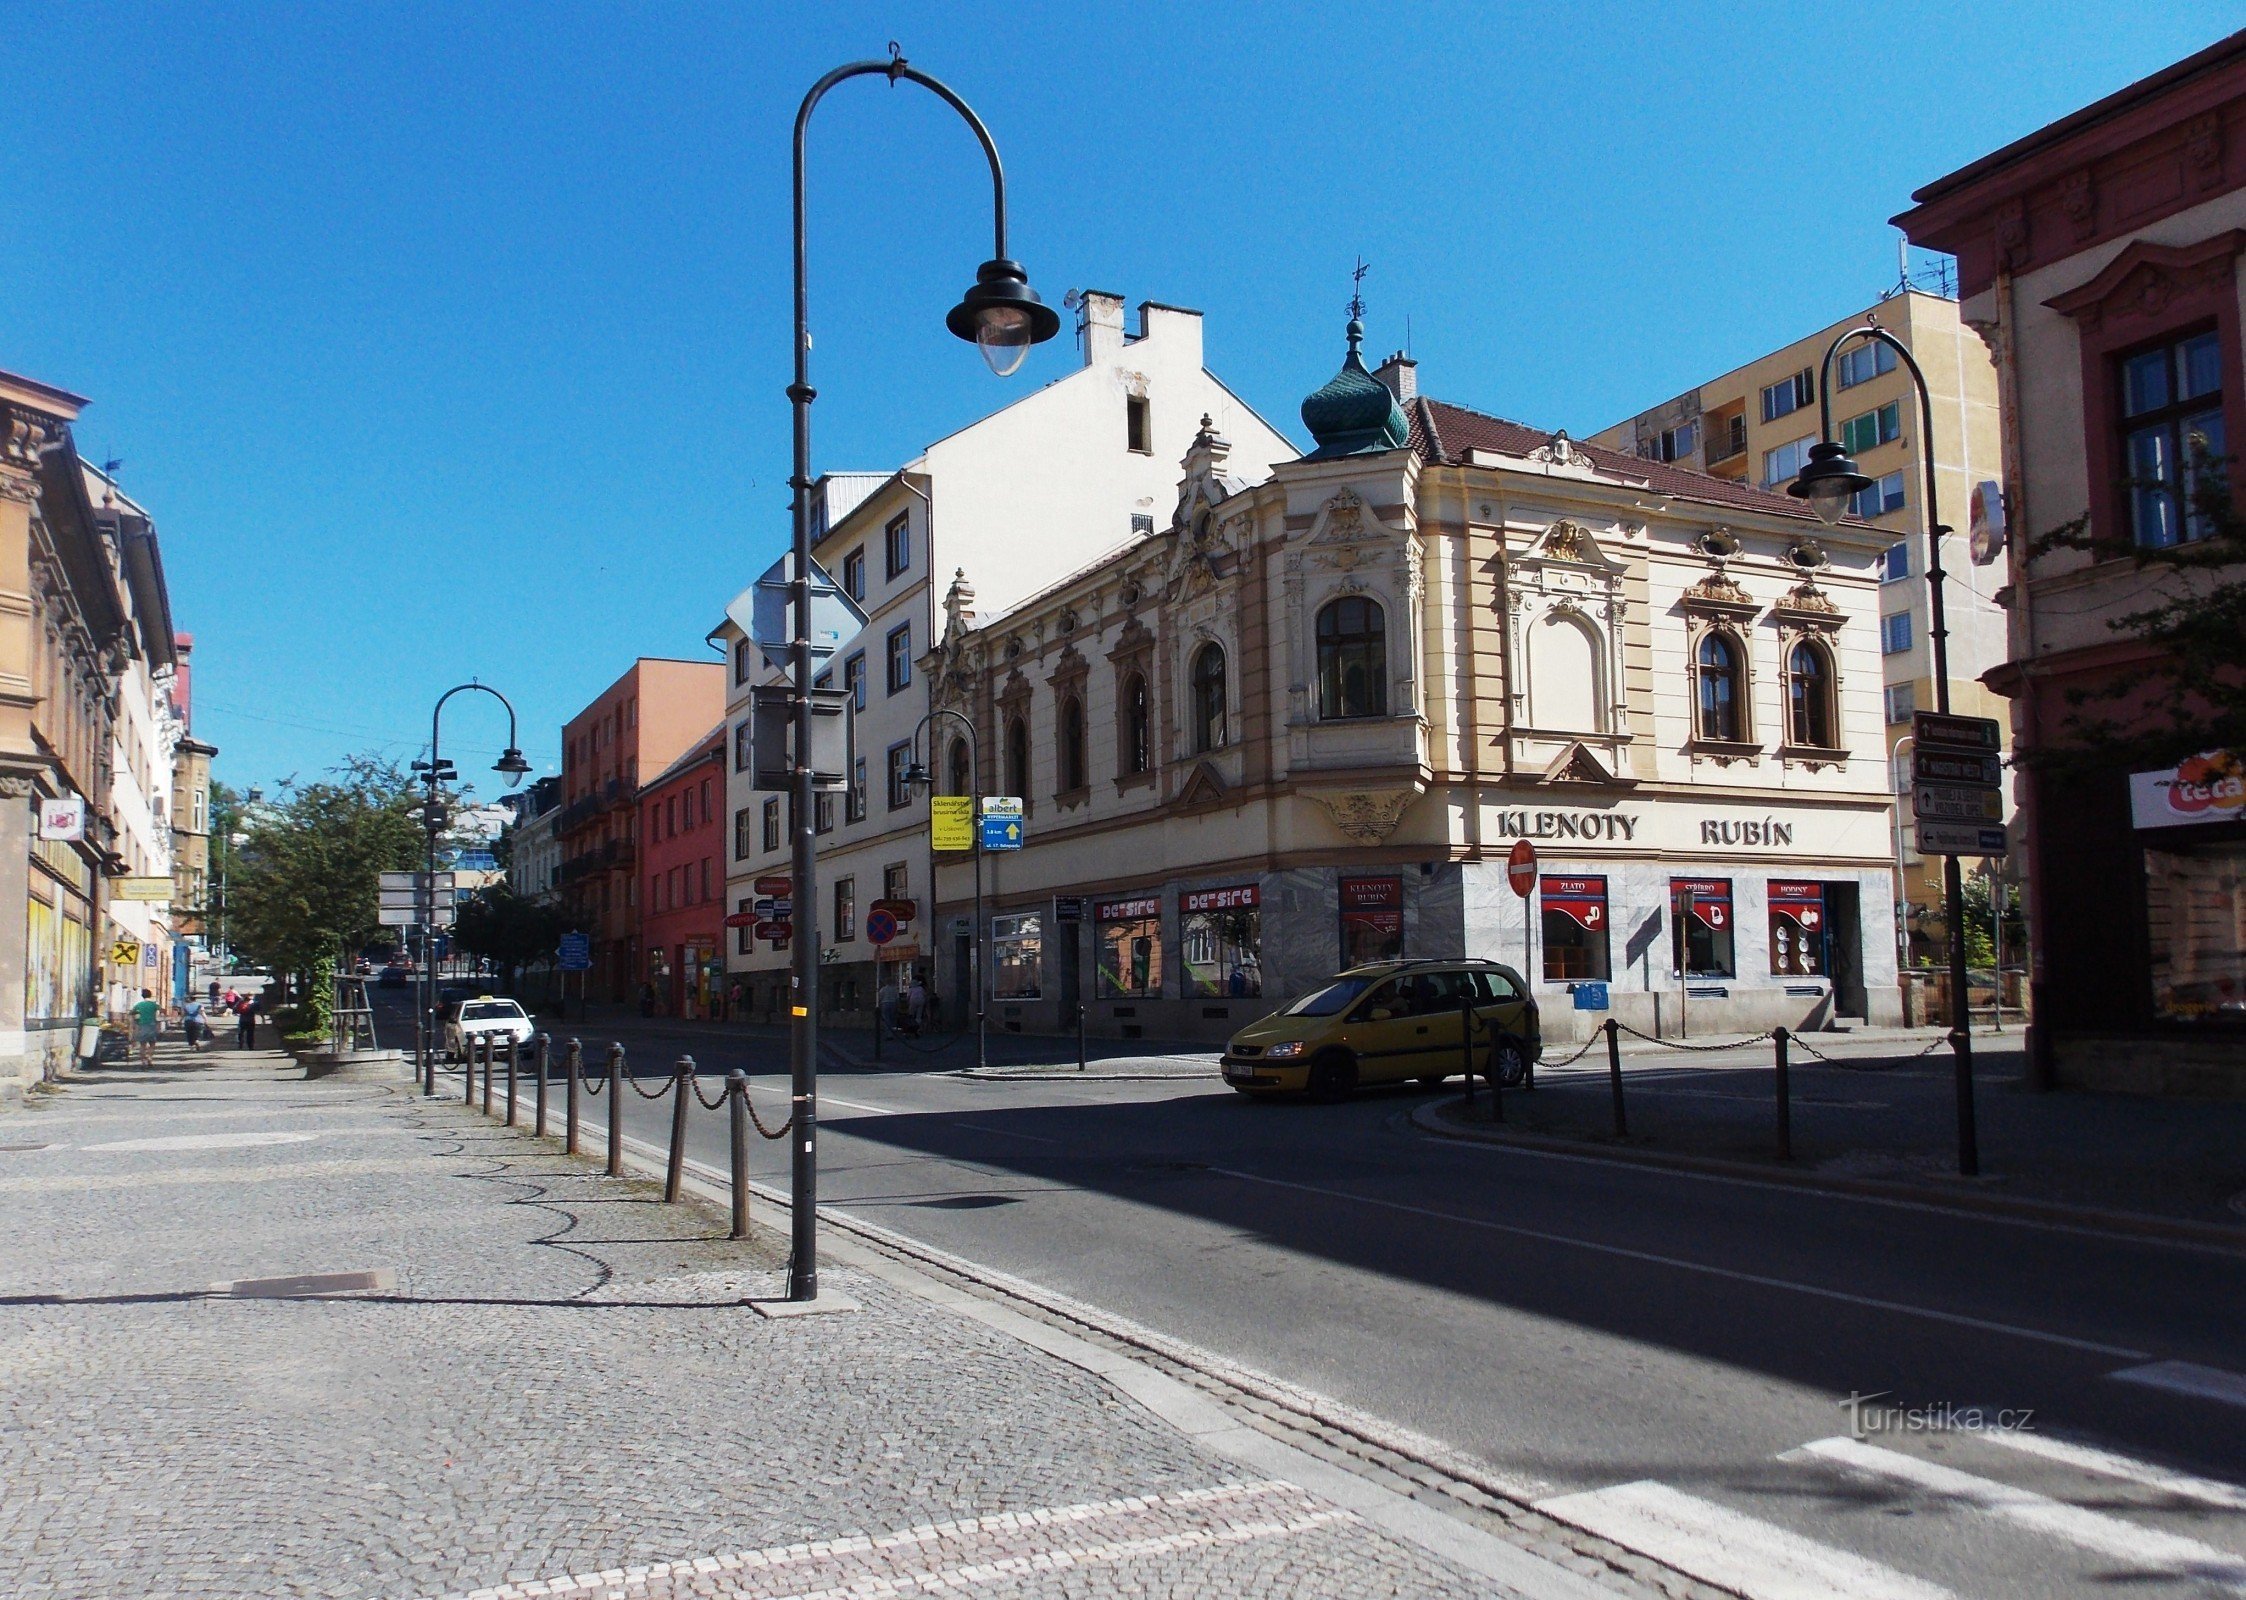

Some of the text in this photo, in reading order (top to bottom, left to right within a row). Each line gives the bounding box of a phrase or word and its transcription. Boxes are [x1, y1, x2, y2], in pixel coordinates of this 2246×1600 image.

[2180, 776, 2242, 802] teta
[988, 804, 1018, 813] albert
[1498, 810, 1793, 847] KLENOTY RUBÍN
[1350, 883, 1394, 893] KLENOTY
[1560, 882, 1586, 891] ZLATO
[1780, 886, 1808, 894] HODINY
